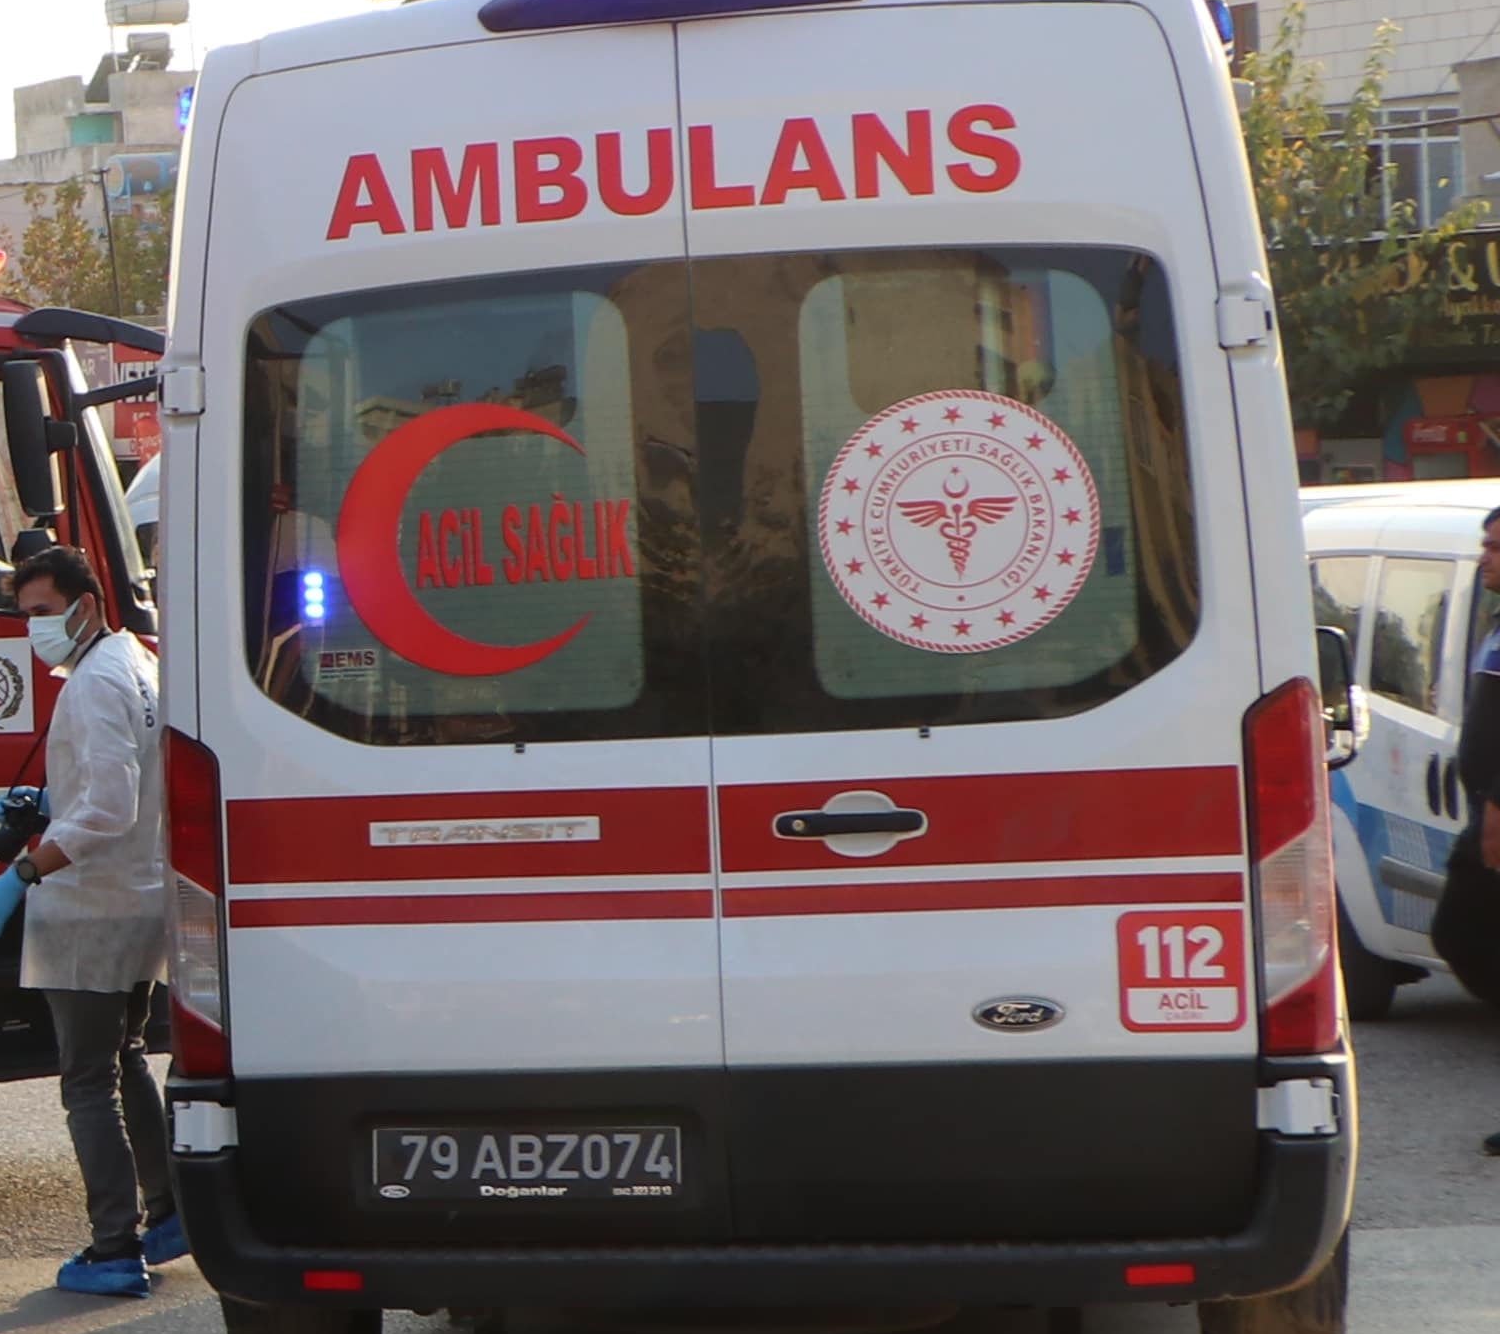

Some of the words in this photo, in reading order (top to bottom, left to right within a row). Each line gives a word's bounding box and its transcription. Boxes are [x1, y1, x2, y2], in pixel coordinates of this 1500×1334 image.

[326, 104, 1021, 240] AMBULANS
[871, 437, 971, 520] CUMHURİYETİ
[977, 442, 1036, 490] SAĞLIK
[417, 508, 493, 588] ACİL
[503, 492, 634, 585] SAĞLIK
[871, 526, 922, 594] TÜRKİYE
[1001, 493, 1047, 589] BAKANLIĞI
[335, 651, 375, 667] EMS
[379, 820, 588, 844] TRANSIT
[1137, 925, 1225, 979] 112
[993, 1002, 1043, 1024] Ford
[1158, 989, 1208, 1010] ACİL
[401, 1134, 460, 1181] 79
[470, 1133, 673, 1181] ABZ074
[479, 1183, 568, 1198] Doğanlar
